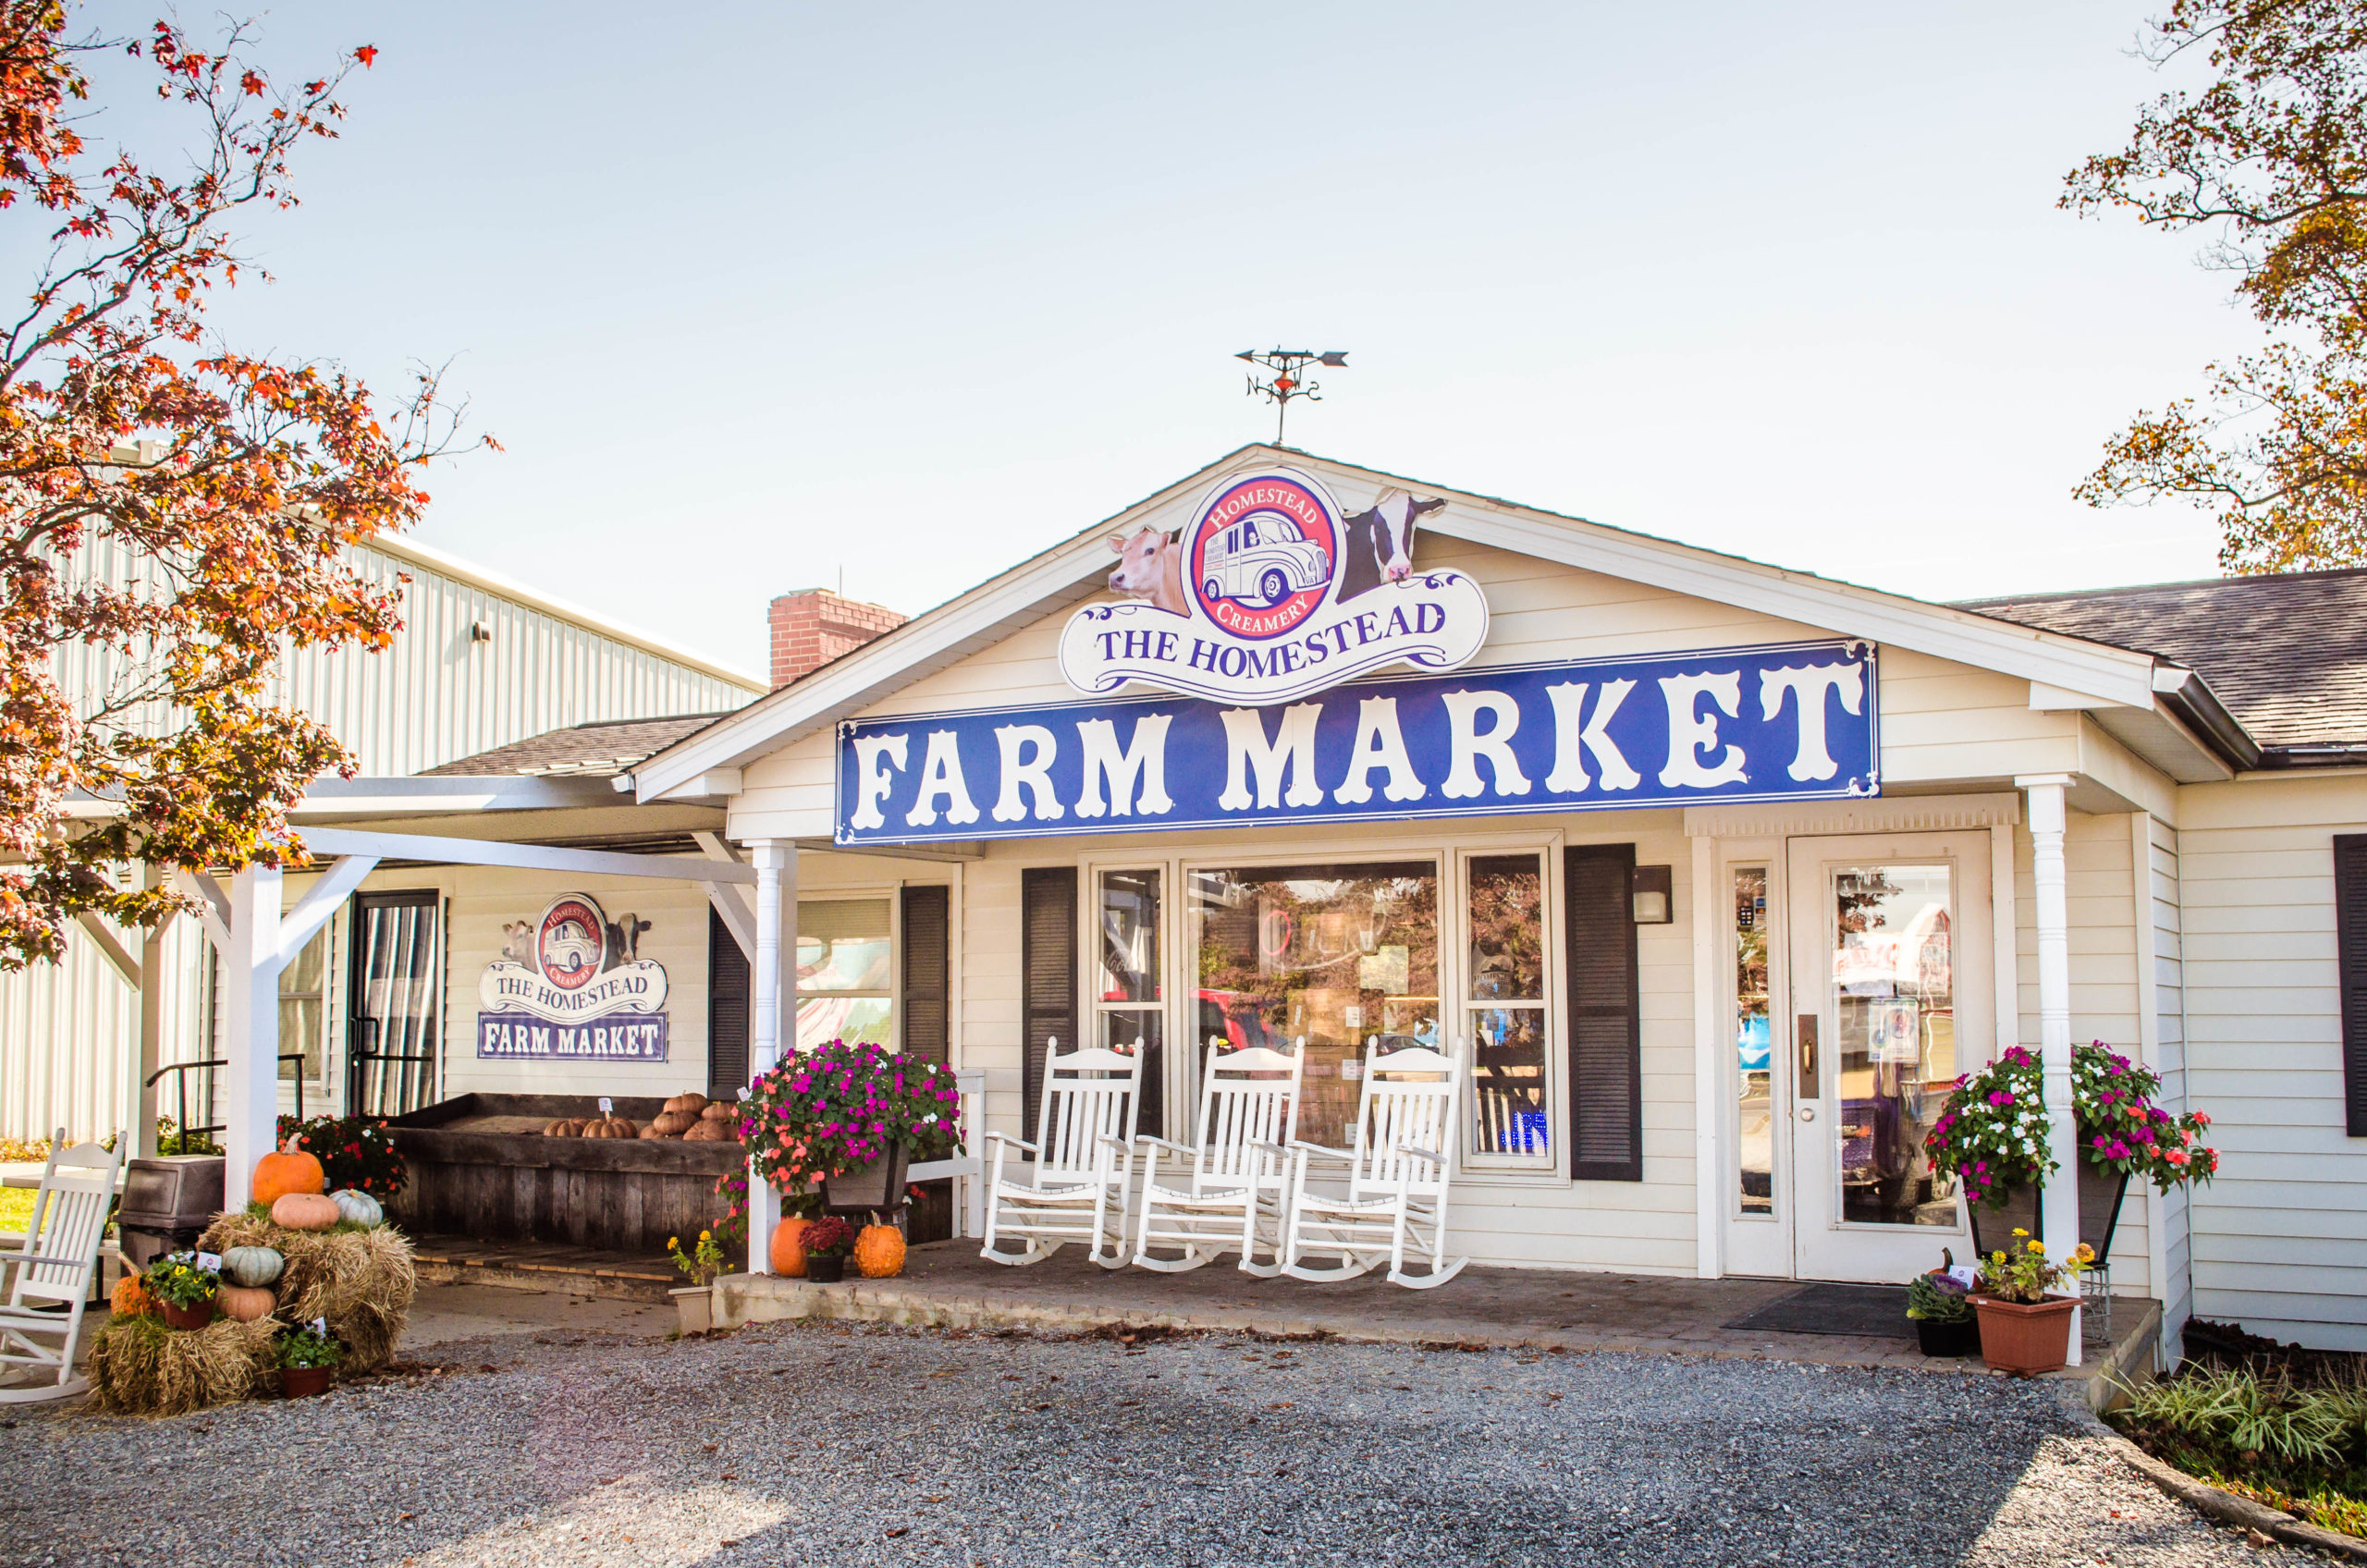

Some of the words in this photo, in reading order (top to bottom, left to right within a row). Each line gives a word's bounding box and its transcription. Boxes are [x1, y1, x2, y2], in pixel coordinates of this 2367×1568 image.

[1246, 373, 1259, 396] N
[1208, 488, 1317, 530] HOMESTEAD
[1217, 594, 1308, 632] CREAMERY
[1097, 630, 1179, 662] THE
[1187, 603, 1445, 679] HOMESTEAD
[851, 714, 1174, 829] FARM
[1219, 662, 1863, 810] MARKET
[547, 907, 595, 930] HOMESTEAD
[549, 967, 590, 986] CREAMERY
[497, 977, 533, 998] THE
[536, 977, 647, 1011] HOMESTEAD
[484, 1023, 550, 1053] FARM
[558, 1024, 658, 1055] MARKET
[1514, 1112, 1546, 1128] ICE
[1500, 1131, 1549, 1146] CREA
